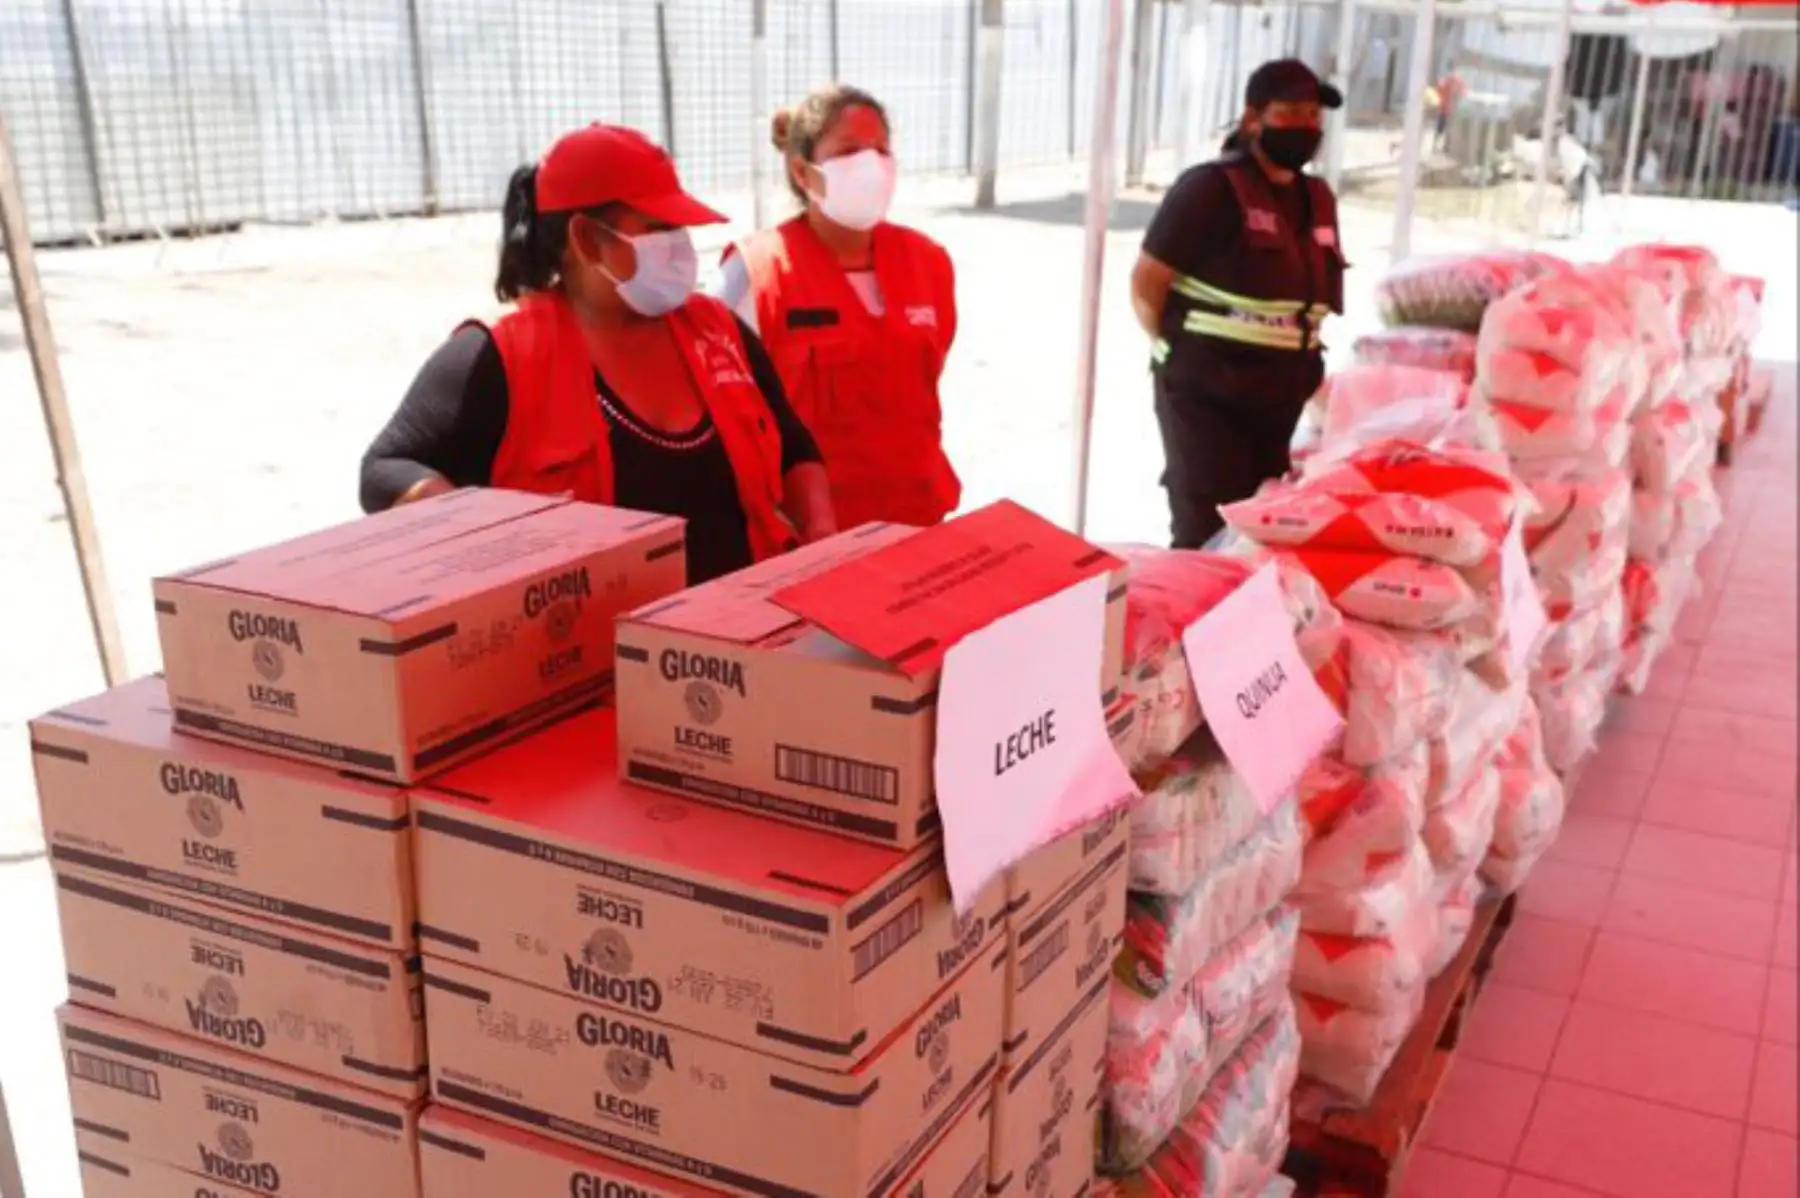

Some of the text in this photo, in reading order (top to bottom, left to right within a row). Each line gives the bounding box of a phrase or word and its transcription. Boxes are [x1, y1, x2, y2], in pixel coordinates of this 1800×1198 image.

[228, 609, 303, 654] GLORIA
[659, 648, 746, 698] GLORIA
[1235, 661, 1287, 719] QUINUA
[248, 684, 296, 710] LECHE
[674, 726, 733, 754] LECHE
[995, 708, 1056, 776] LECHE
[161, 762, 244, 815] GLORIA
[181, 839, 238, 869] LECHE
[577, 891, 644, 929] LECHE
[191, 944, 245, 977] LECHE
[563, 953, 663, 1014] GLORIA
[185, 998, 266, 1048] GLORIA
[576, 1011, 674, 1071] GLORIA
[205, 1092, 259, 1125] LECHE
[595, 1091, 661, 1128] LECHE
[197, 1141, 281, 1192] GLORIA
